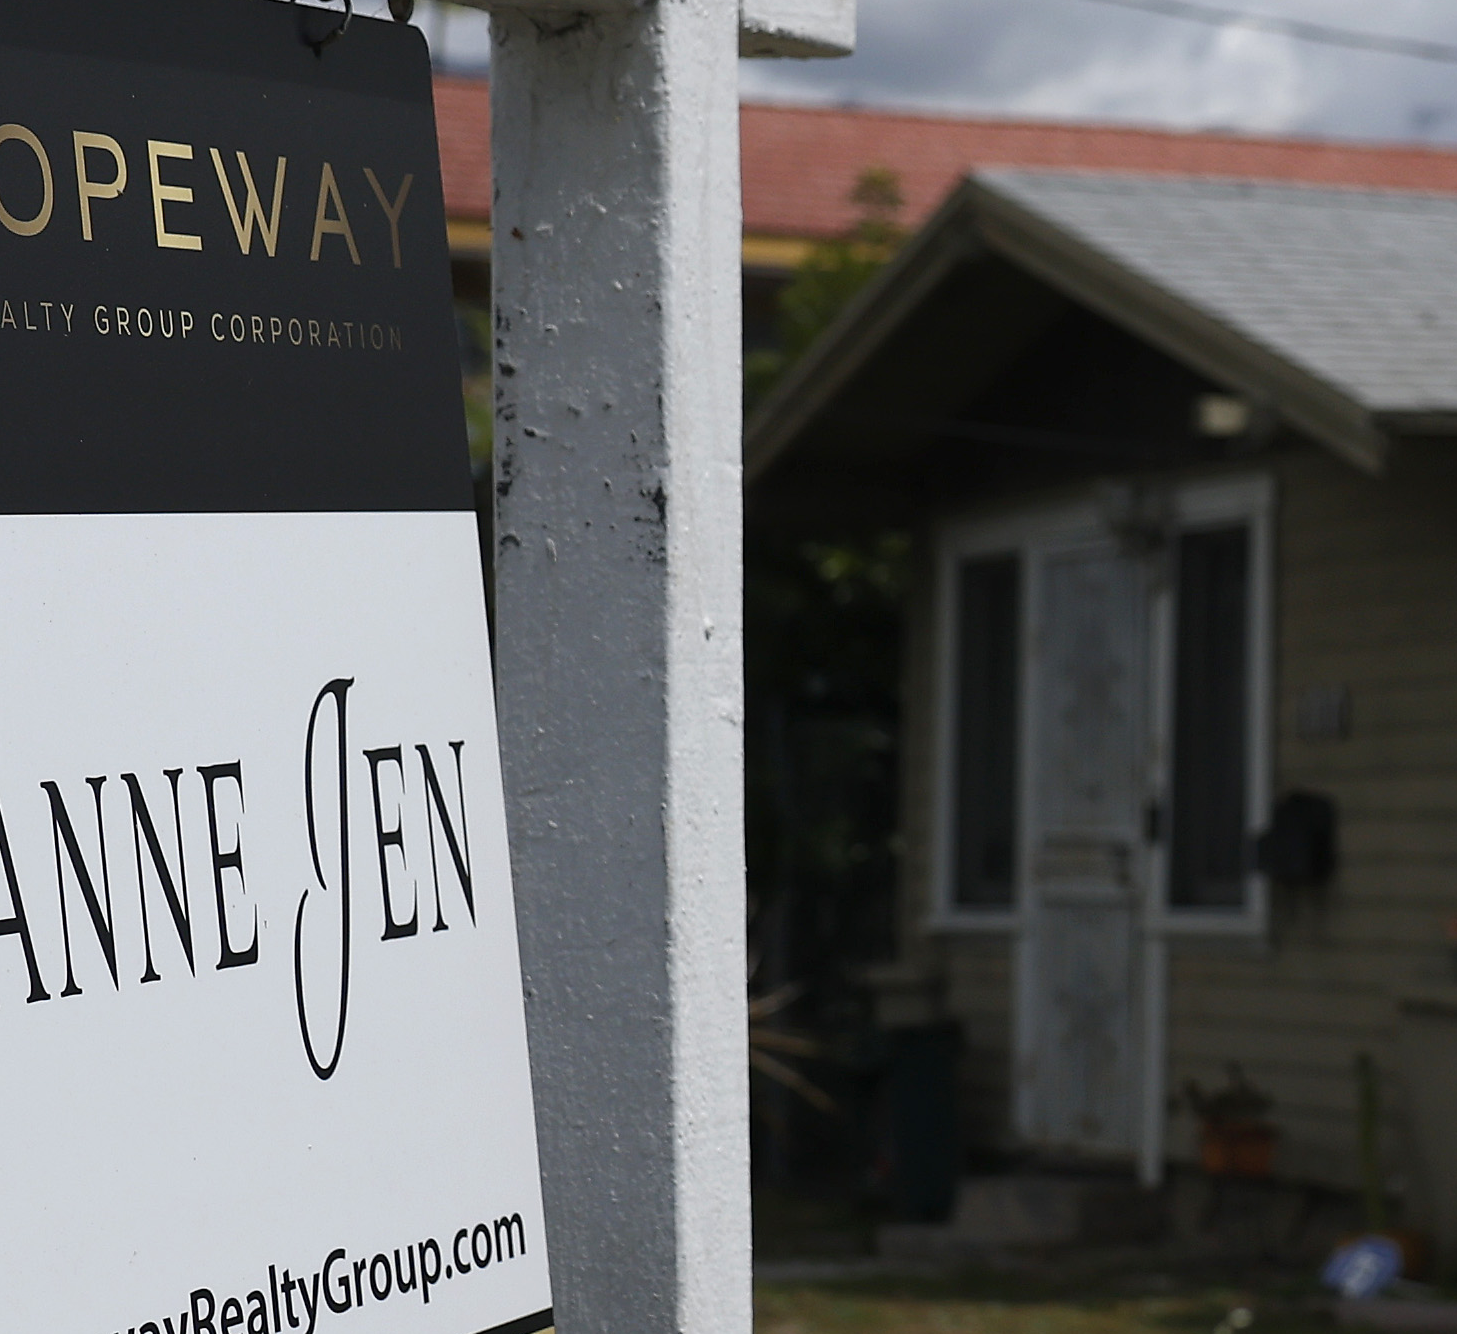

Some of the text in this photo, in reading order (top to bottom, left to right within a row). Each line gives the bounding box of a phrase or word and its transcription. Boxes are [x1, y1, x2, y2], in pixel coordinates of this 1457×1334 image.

[93, 305, 195, 340] GROUP
[211, 312, 403, 352] CORPORATION
[294, 676, 478, 1081] JEN
